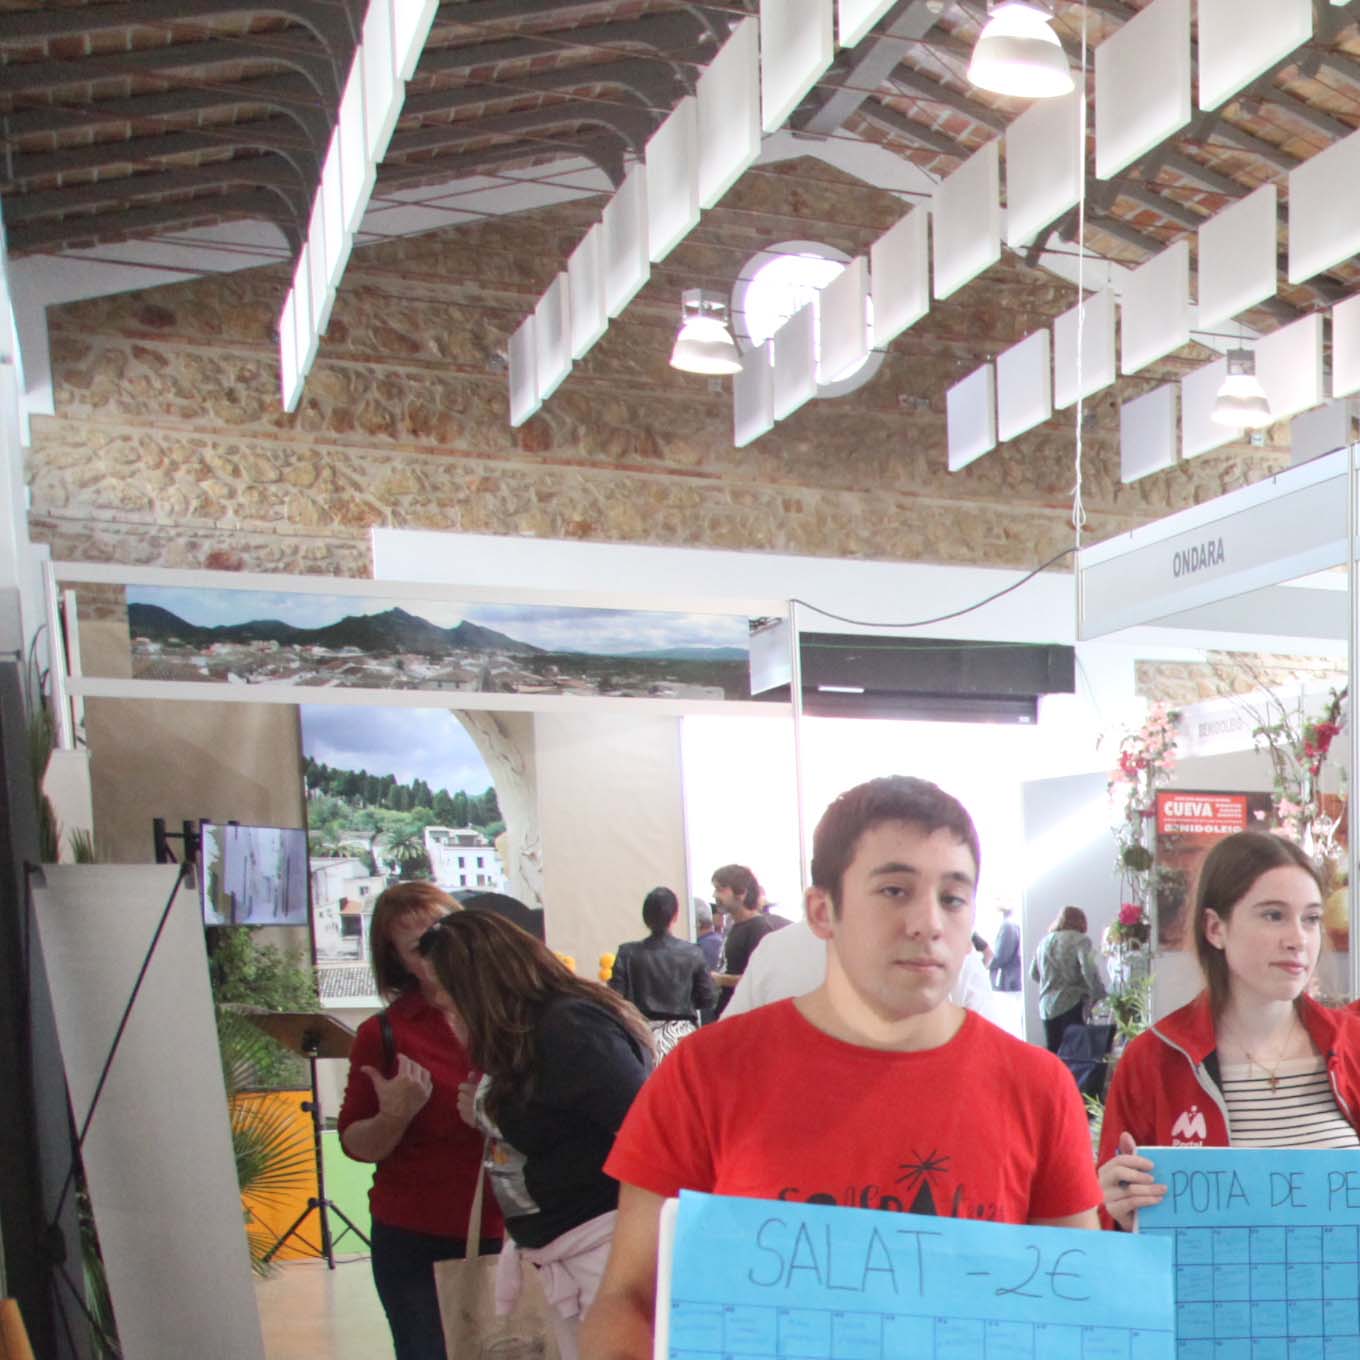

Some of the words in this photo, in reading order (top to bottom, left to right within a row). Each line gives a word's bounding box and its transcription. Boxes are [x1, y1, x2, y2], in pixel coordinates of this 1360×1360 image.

[1173, 535, 1225, 578] ONDARA
[1163, 801, 1214, 818] CUEVA
[1171, 1169, 1251, 1215] POTA
[1268, 1171, 1308, 1209] DE
[748, 1217, 943, 1297] SALAT
